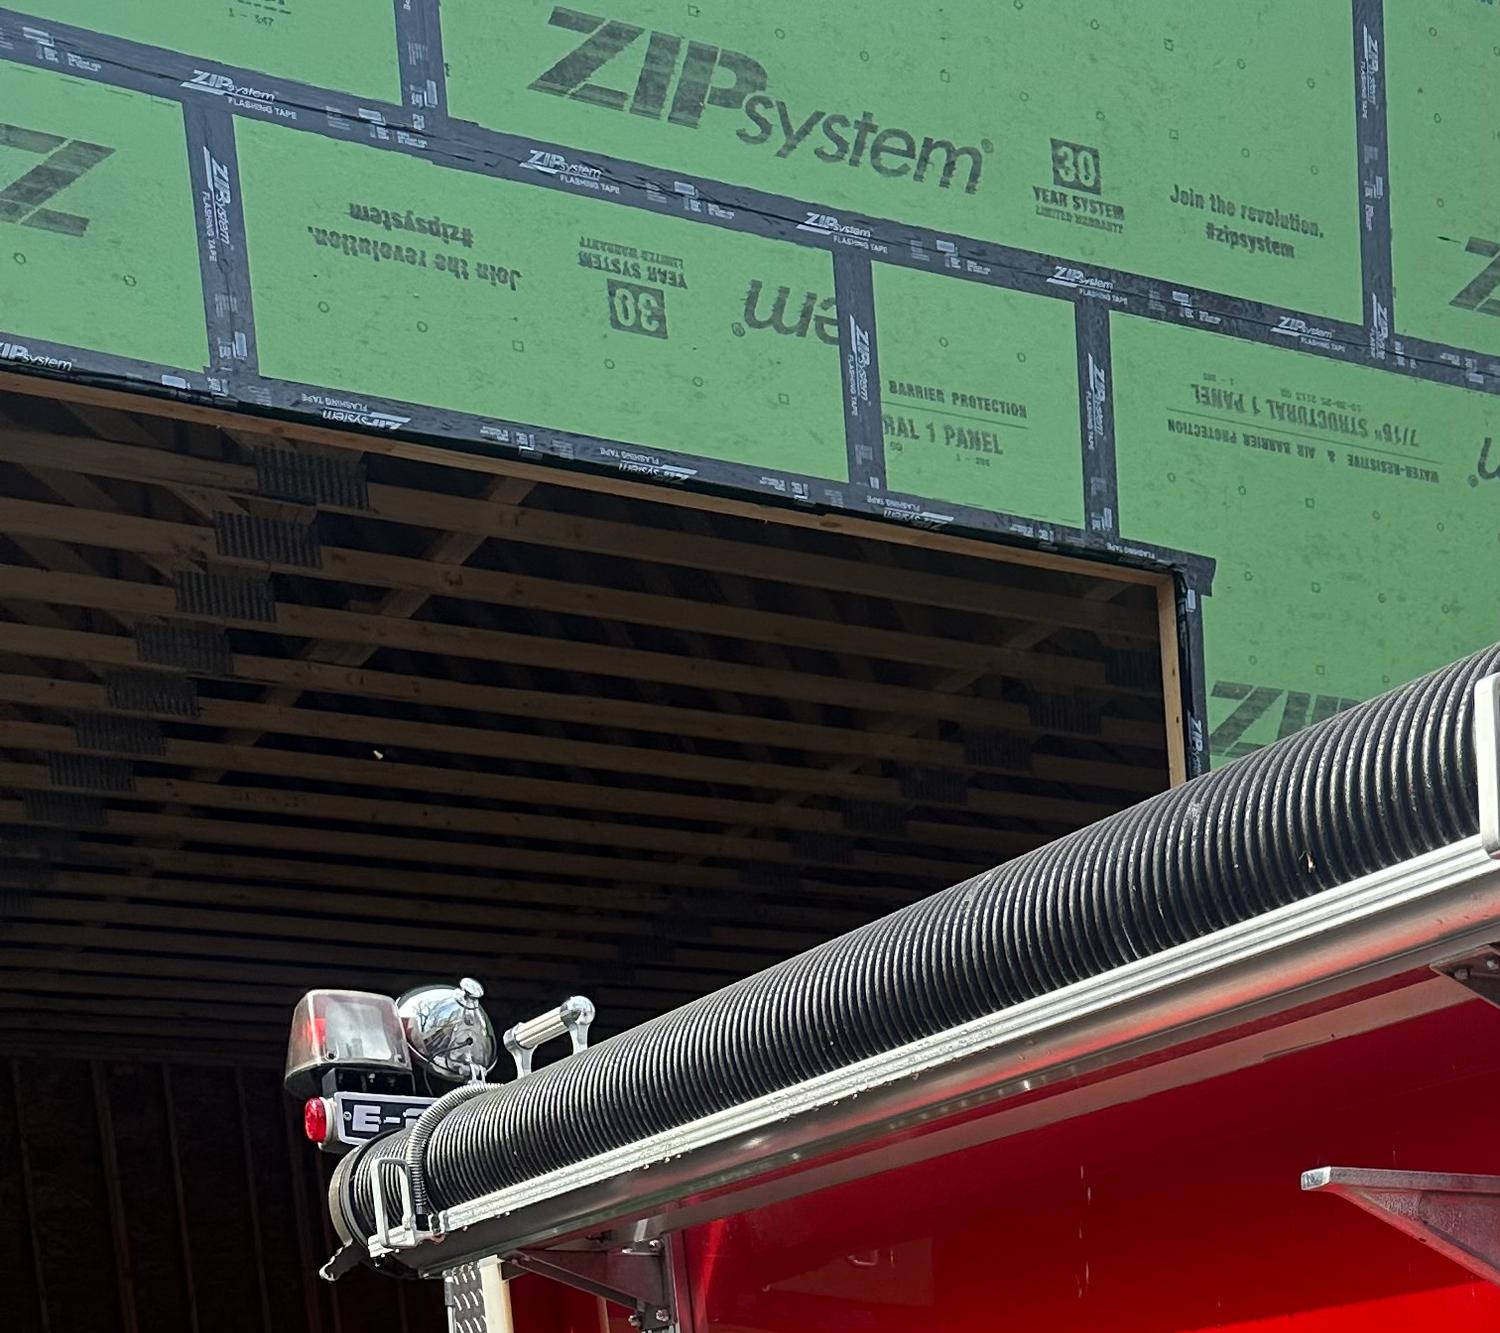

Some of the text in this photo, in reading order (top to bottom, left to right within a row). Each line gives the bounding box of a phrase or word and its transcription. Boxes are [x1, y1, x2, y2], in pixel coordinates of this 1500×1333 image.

[275, 105, 298, 121] TAPE
[1056, 145, 1097, 188] 30
[1032, 185, 1125, 221] YEAR SYSTEM
[1169, 183, 1204, 210] Join
[1209, 193, 1236, 218] the
[348, 202, 474, 249] #zipsystem
[1206, 222, 1296, 259] #zipsystem
[433, 252, 470, 281] the
[475, 262, 523, 292] Join
[576, 250, 688, 291] YEAR SYSTEM
[615, 285, 662, 333] 30
[888, 380, 1028, 419] BARRIER PROTECTION
[1190, 383, 1245, 414] PANEL
[1251, 396, 1261, 416] 1
[1167, 419, 1238, 445] PROTECTION
[1265, 399, 1369, 438] STRUCTURAL
[925, 421, 936, 443] 1
[943, 423, 1004, 456] PANEL
[1242, 432, 1291, 455] BARRIER
[1296, 444, 1316, 460] AIR
[1346, 453, 1440, 484] WATER-RESISTIVE
